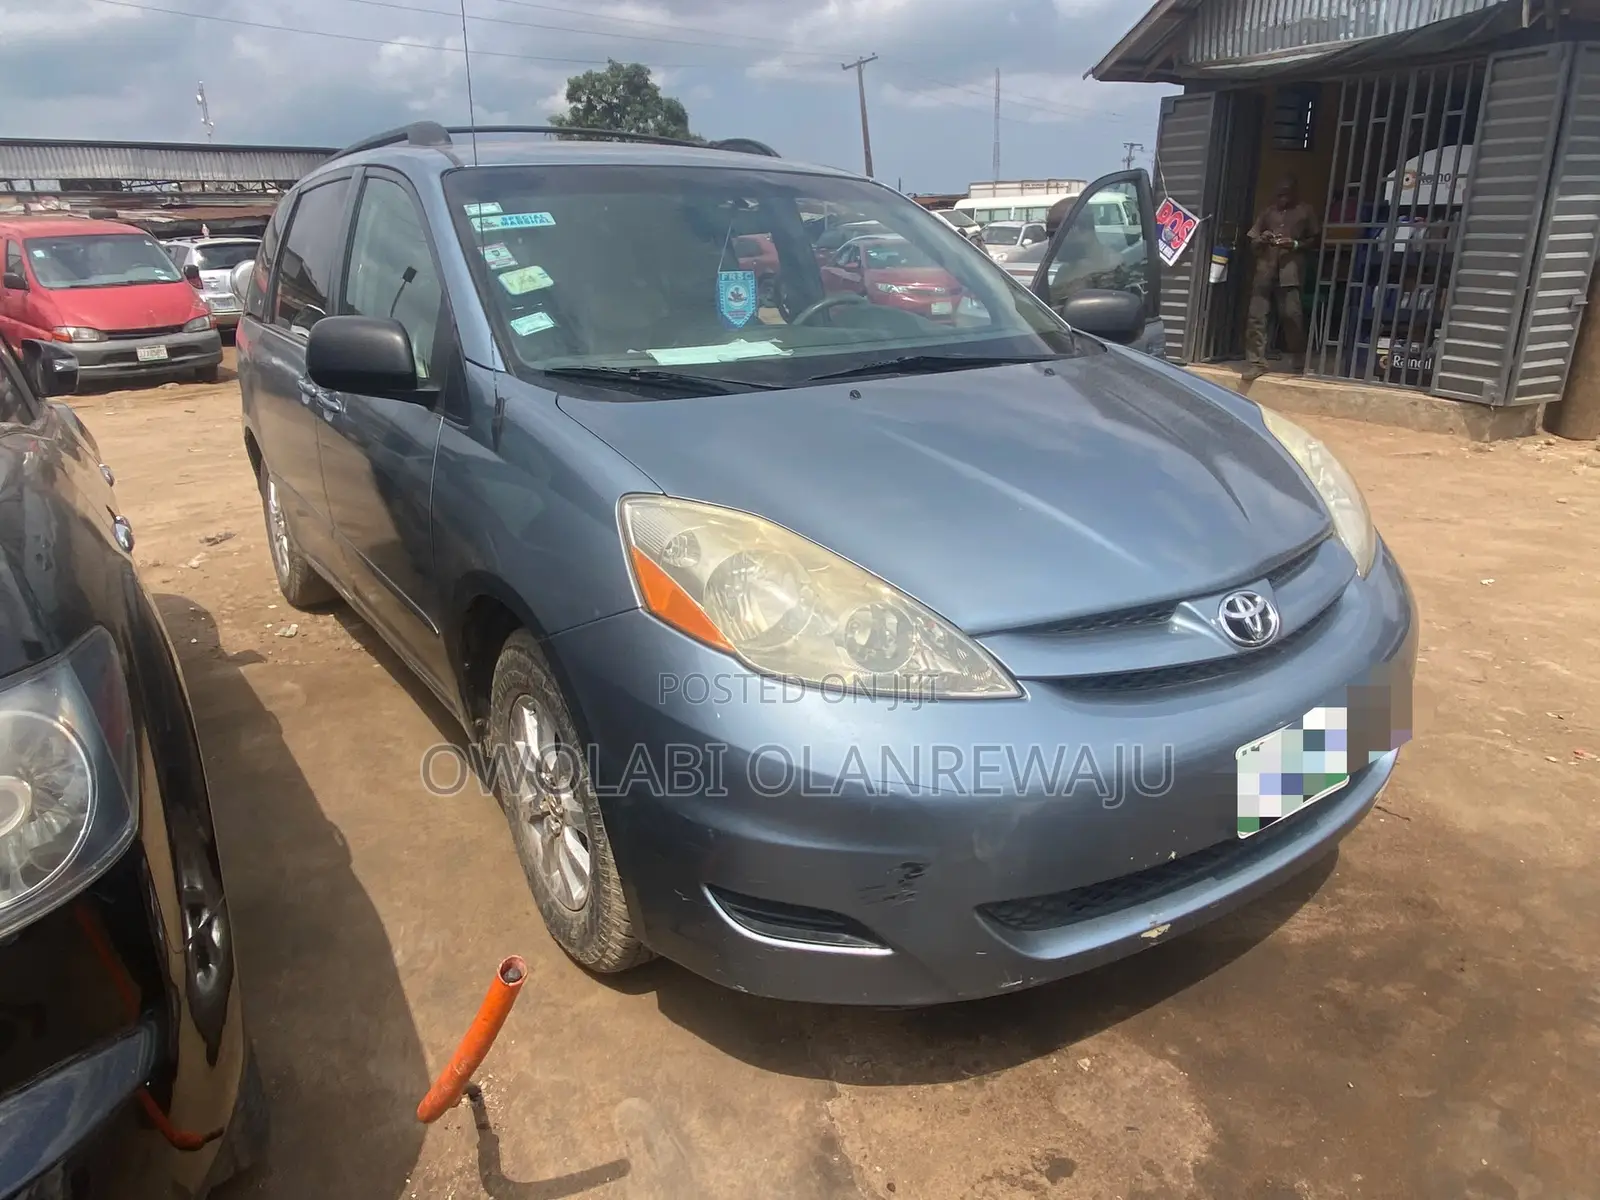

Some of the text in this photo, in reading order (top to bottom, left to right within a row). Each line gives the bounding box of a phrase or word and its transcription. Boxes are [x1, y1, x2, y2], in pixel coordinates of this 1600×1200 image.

[500, 218, 552, 227] MARSHAL
[501, 214, 544, 222] SPECIAL
[721, 272, 752, 281] FRSC
